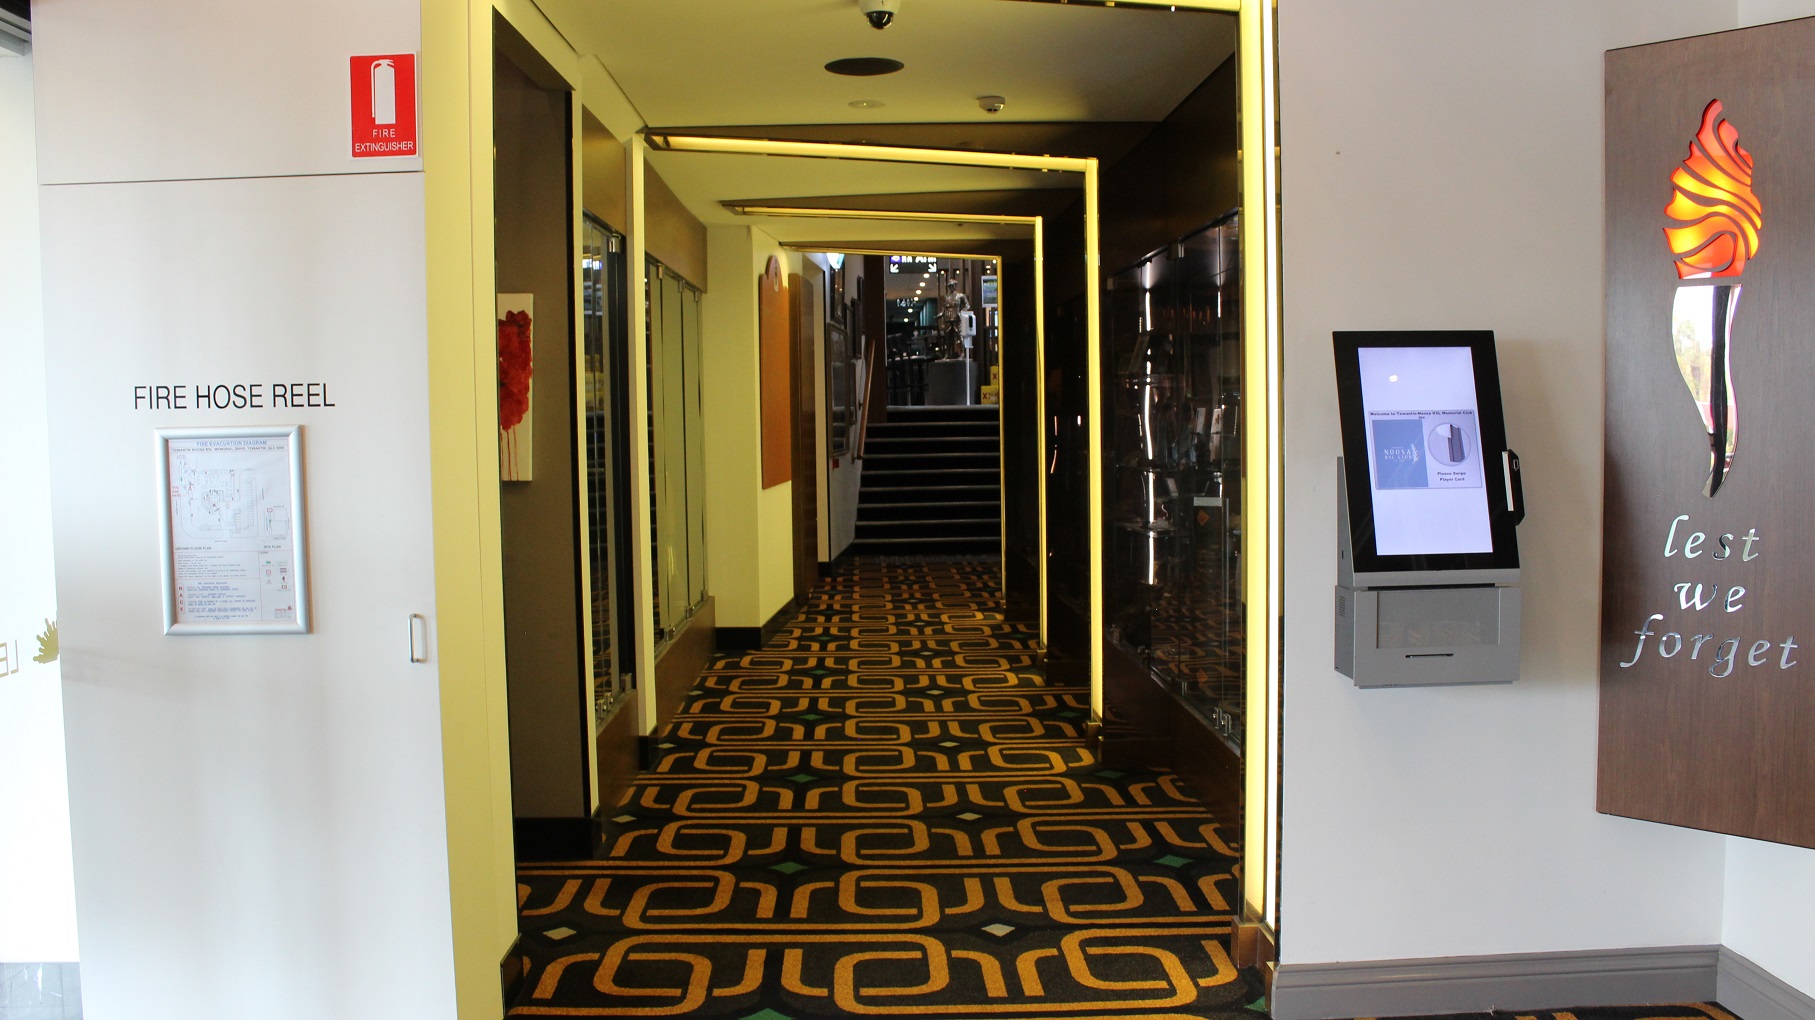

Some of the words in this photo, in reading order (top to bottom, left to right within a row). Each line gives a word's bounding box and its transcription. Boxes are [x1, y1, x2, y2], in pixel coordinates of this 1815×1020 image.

[355, 141, 414, 152] EXTINGUISHER
[372, 128, 396, 138] FIRE
[134, 385, 187, 410] FIRE
[196, 384, 263, 409] HOSE
[272, 383, 336, 408] REEL
[1664, 514, 1760, 562] lest
[1673, 582, 1746, 613] we
[1619, 613, 1798, 678] forget
